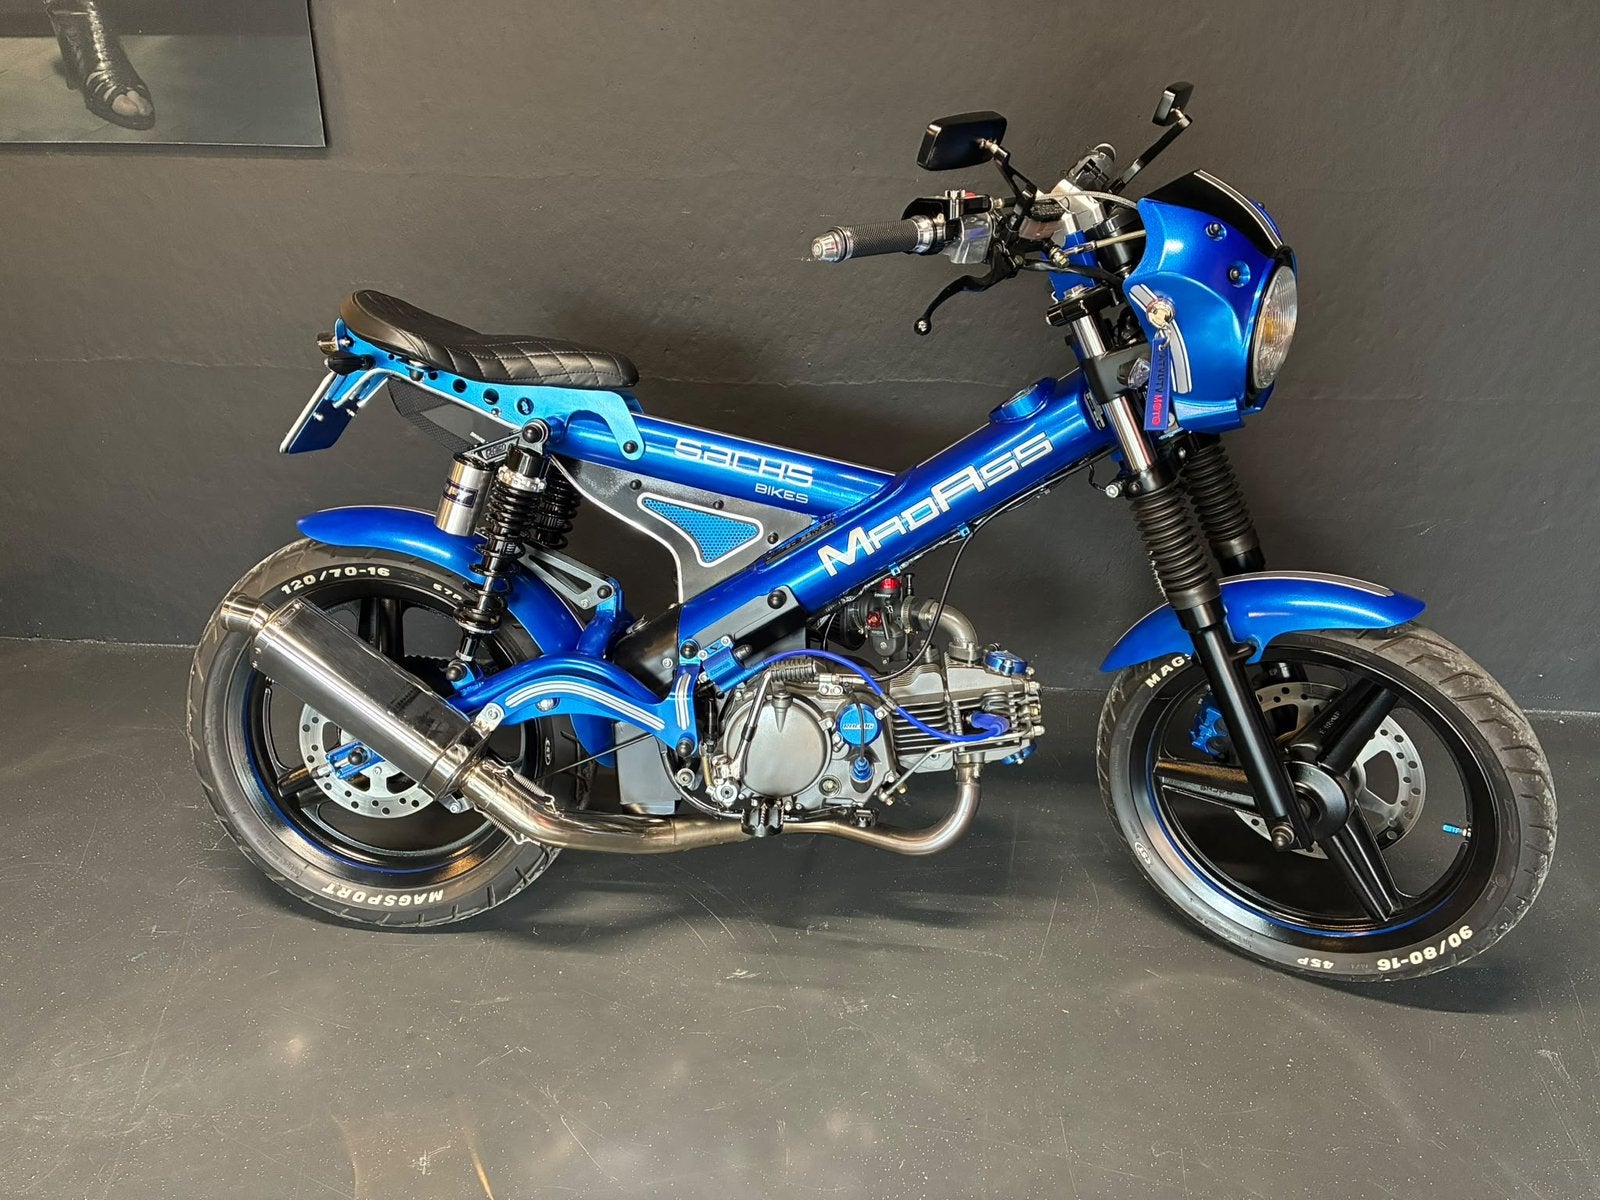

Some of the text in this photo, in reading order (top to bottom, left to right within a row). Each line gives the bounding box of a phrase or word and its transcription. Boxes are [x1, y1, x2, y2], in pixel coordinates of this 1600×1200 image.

[1152, 395, 1163, 425] MOTO
[754, 482, 809, 504] BIKES
[280, 566, 390, 595] 120/70-16
[320, 881, 444, 907] MAGSPORT
[1297, 925, 1474, 972] 90/80-16 45P
